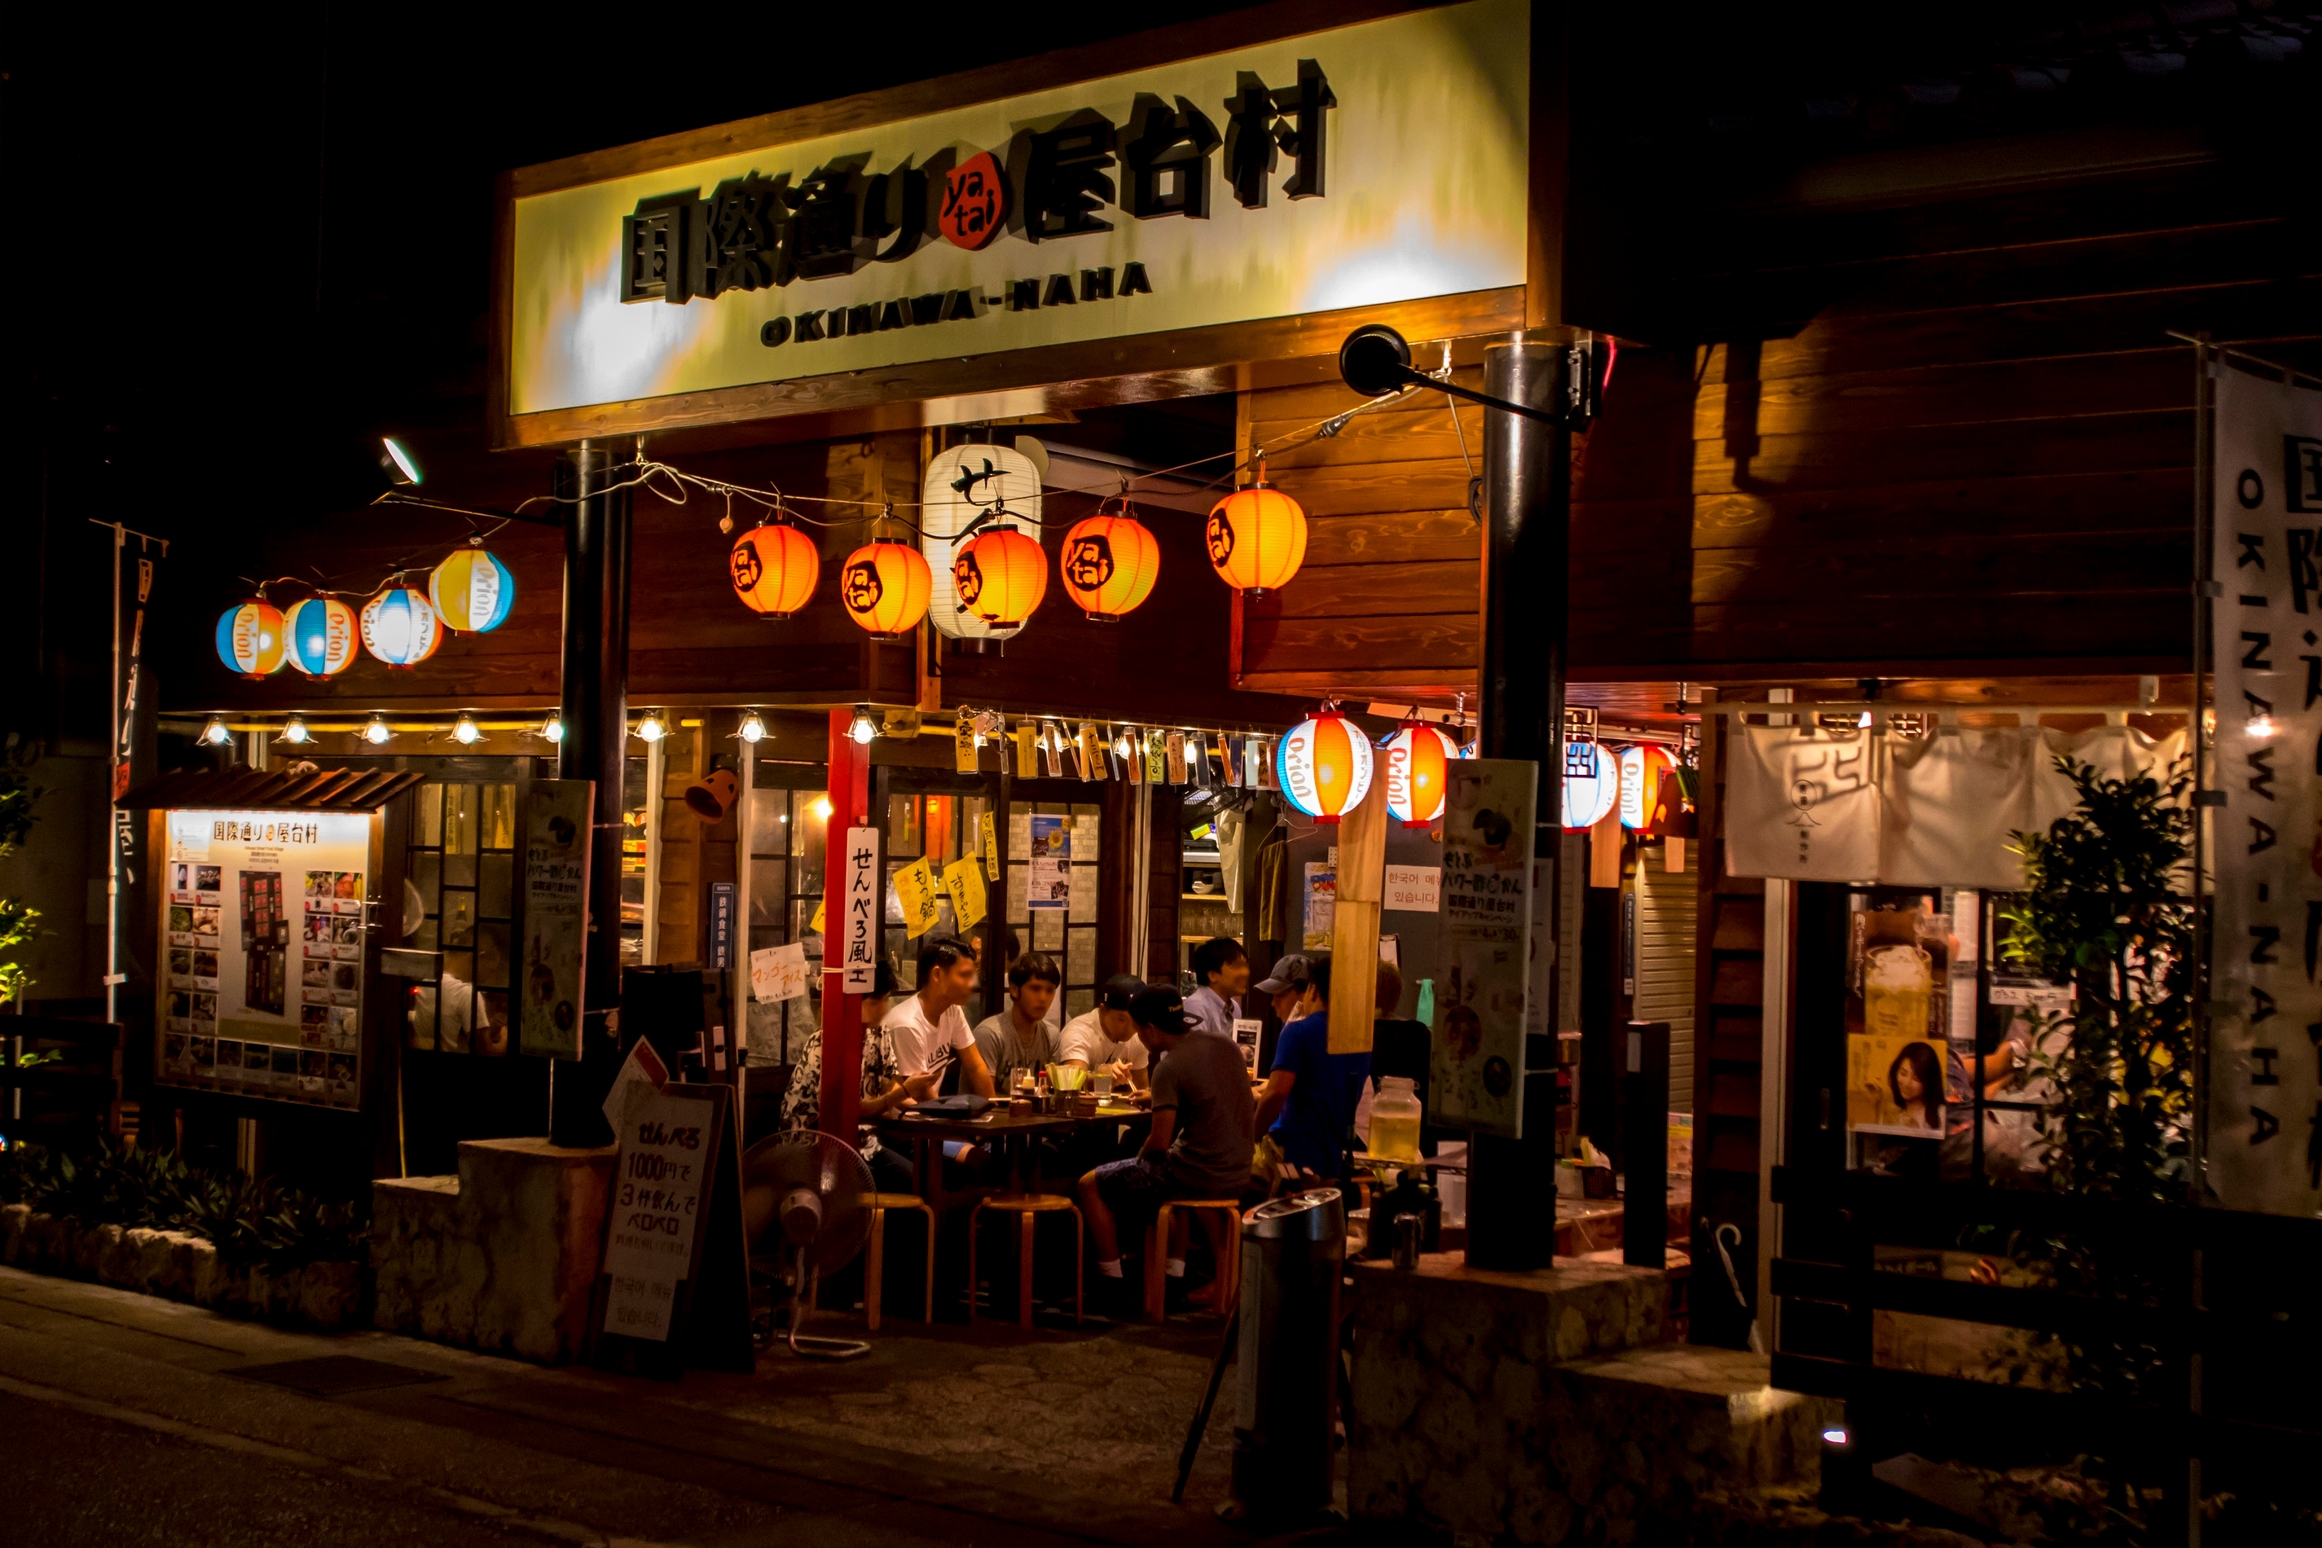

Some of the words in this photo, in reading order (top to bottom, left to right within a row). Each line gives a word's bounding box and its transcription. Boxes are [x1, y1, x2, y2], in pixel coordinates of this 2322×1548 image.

[944, 166, 985, 205] ya
[1026, 58, 1338, 244] 屋台村
[621, 160, 928, 304] 国際通り
[954, 187, 995, 237] tai
[761, 262, 1152, 347] OKINAWA-NAHA
